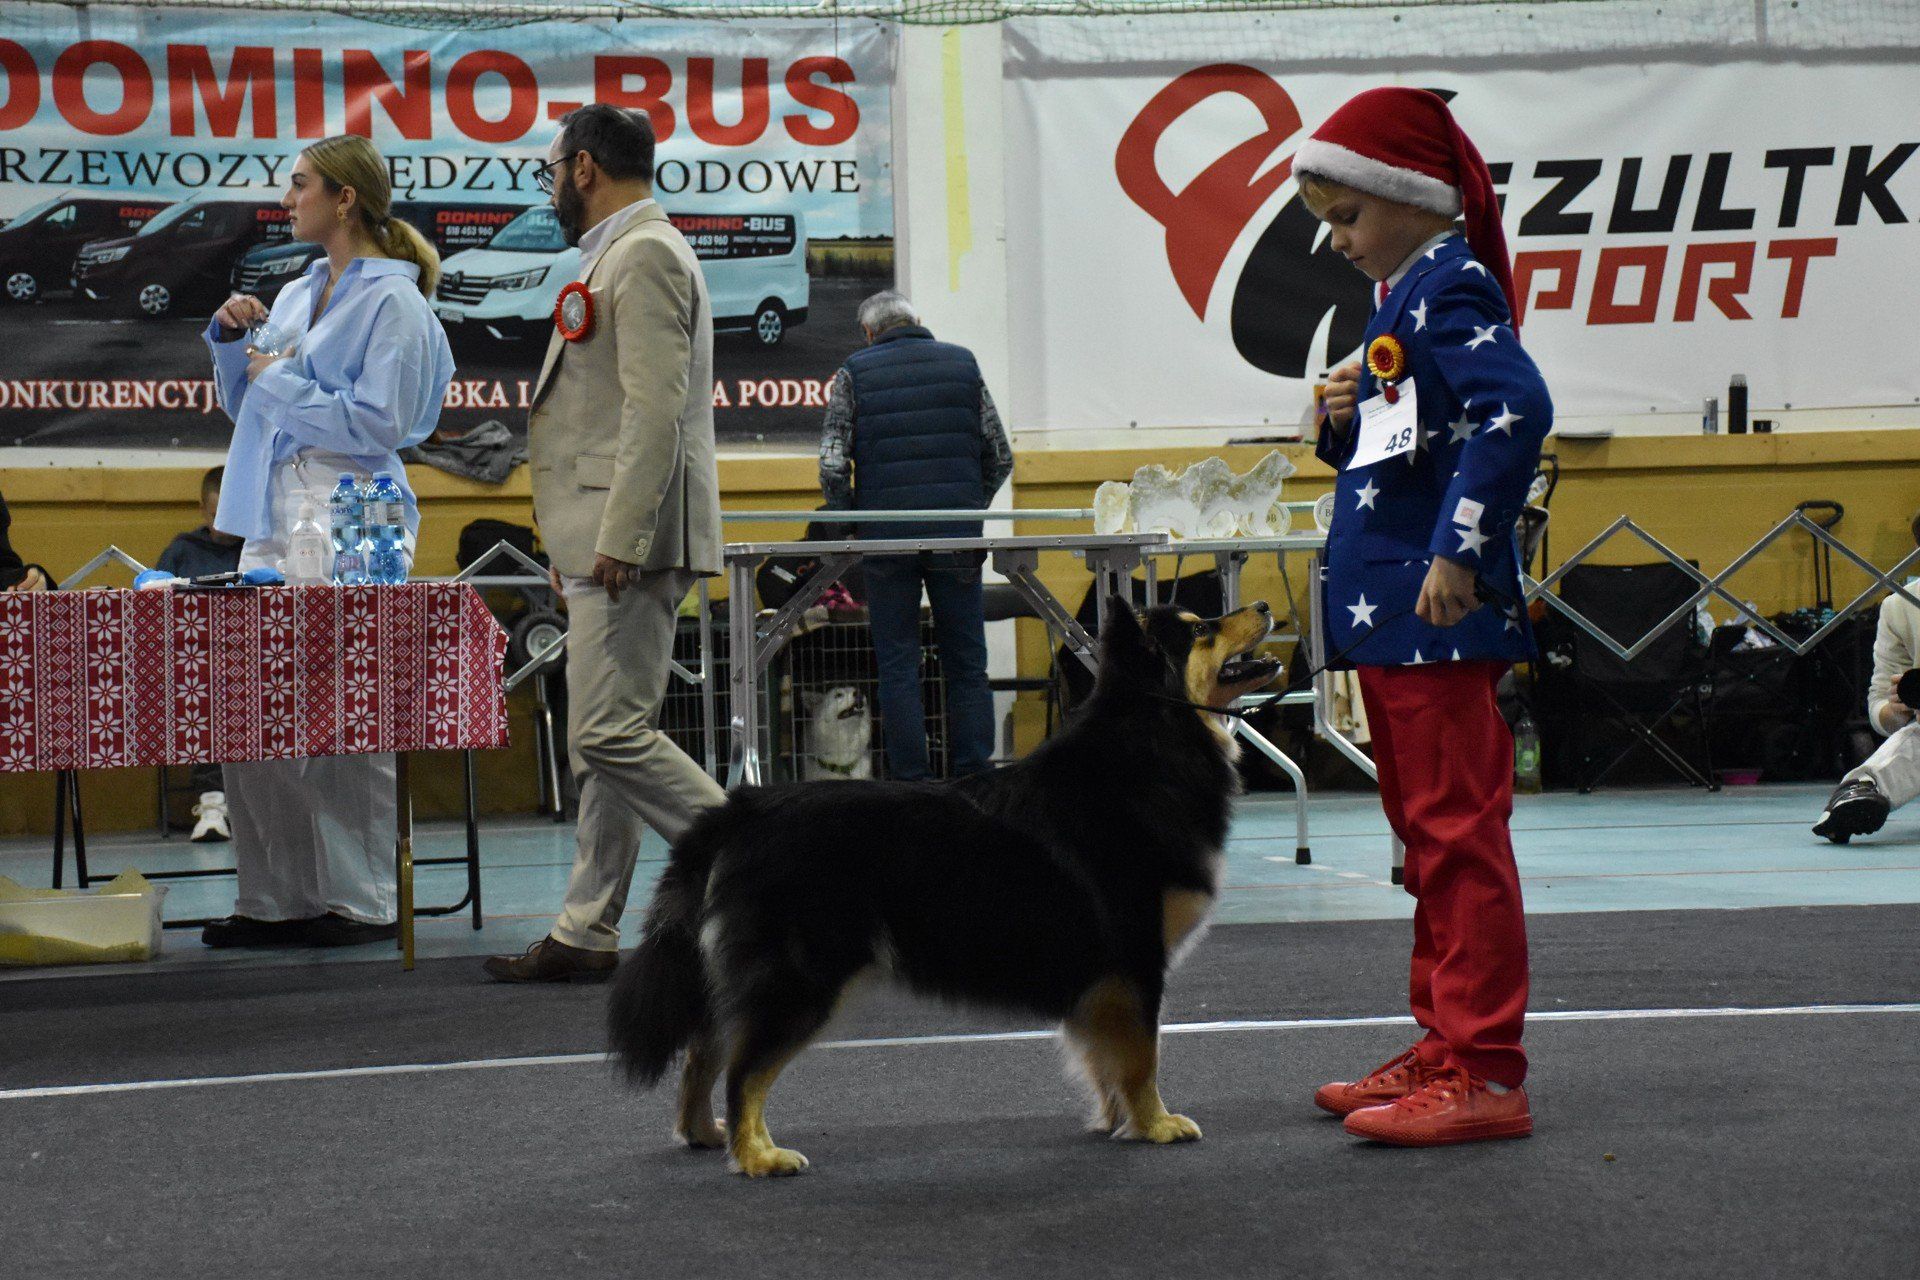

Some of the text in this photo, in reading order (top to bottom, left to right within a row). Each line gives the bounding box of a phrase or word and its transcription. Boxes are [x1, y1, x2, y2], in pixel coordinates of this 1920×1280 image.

[1487, 143, 1920, 237] ZULTK
[1513, 237, 1838, 327] PORT
[0, 379, 222, 414] NKURENCYJ
[1385, 426, 1413, 453] 48
